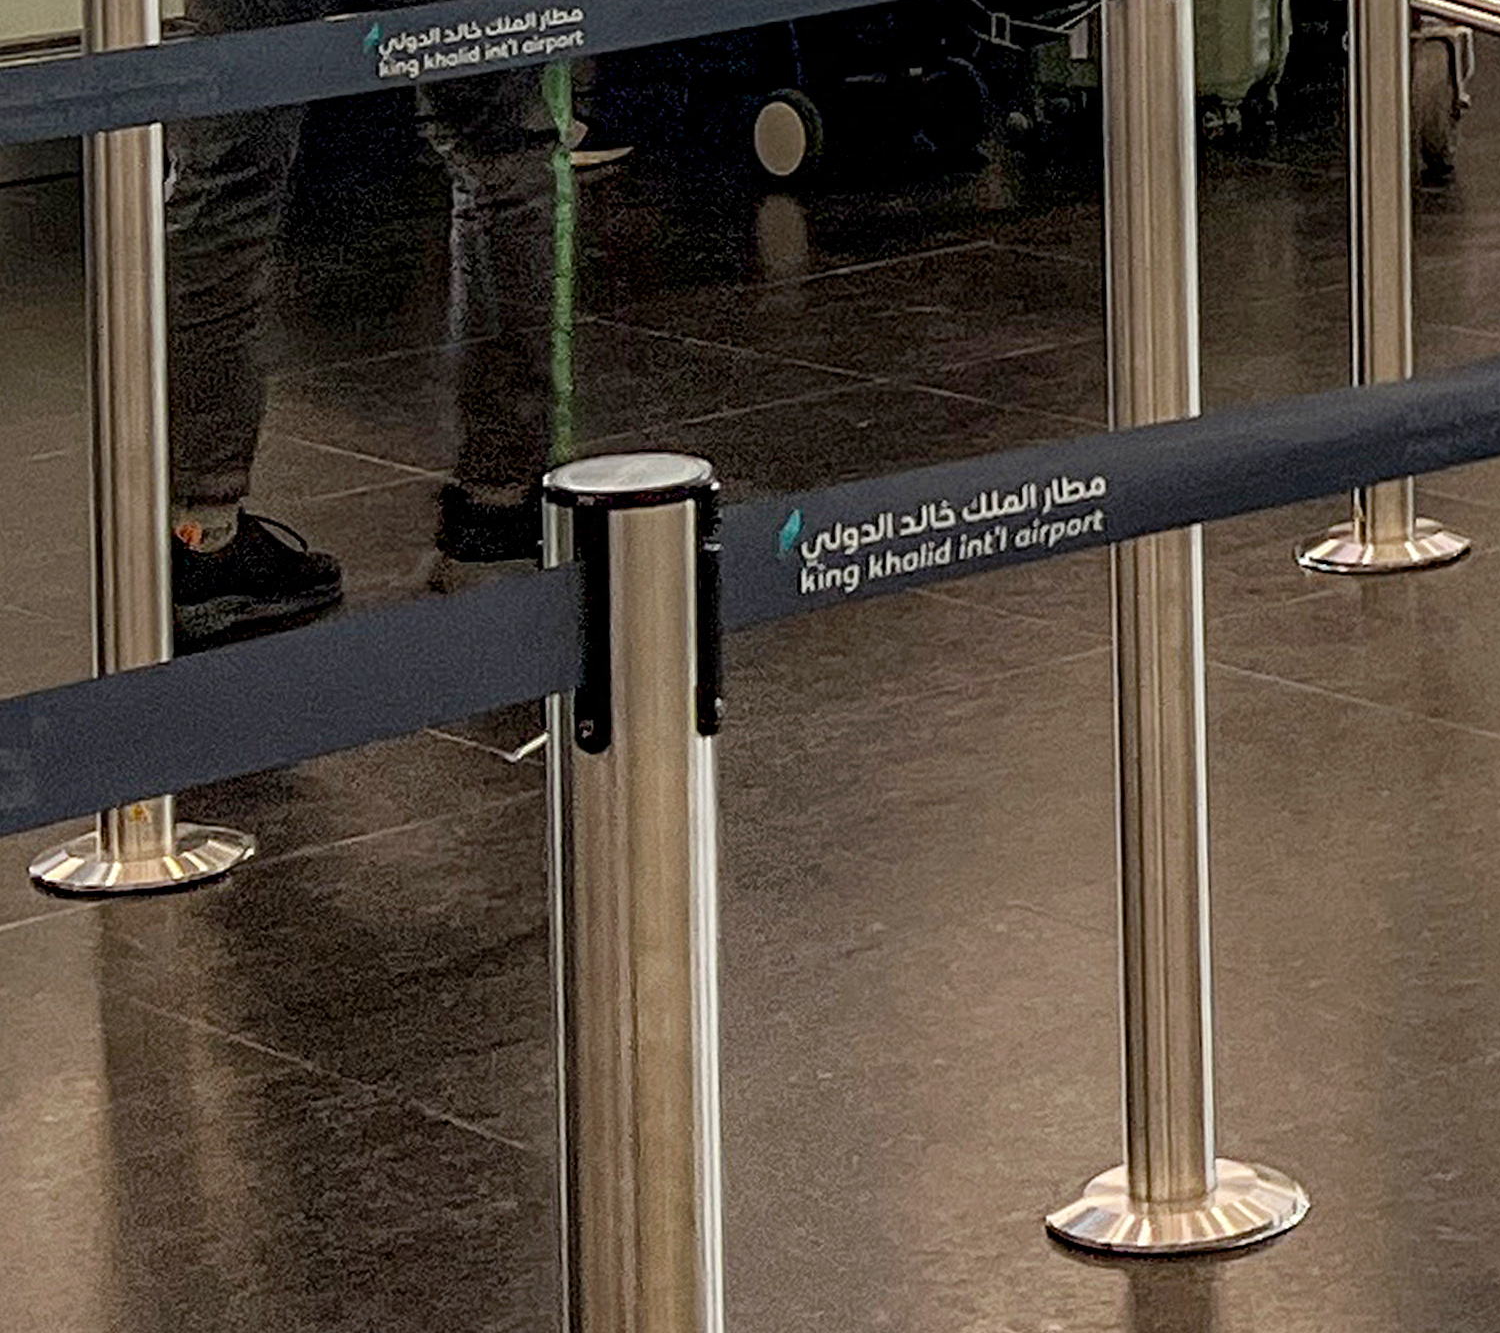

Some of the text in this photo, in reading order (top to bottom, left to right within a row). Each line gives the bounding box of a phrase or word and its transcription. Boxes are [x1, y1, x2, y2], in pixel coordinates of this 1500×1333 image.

[377, 30, 585, 81] king khalid int'l airport
[378, 6, 585, 60] مطار الملك خالد الدولي
[800, 475, 1108, 570] مطار الملك خالد الدولي
[800, 510, 1105, 595] king khalid int'l airport
